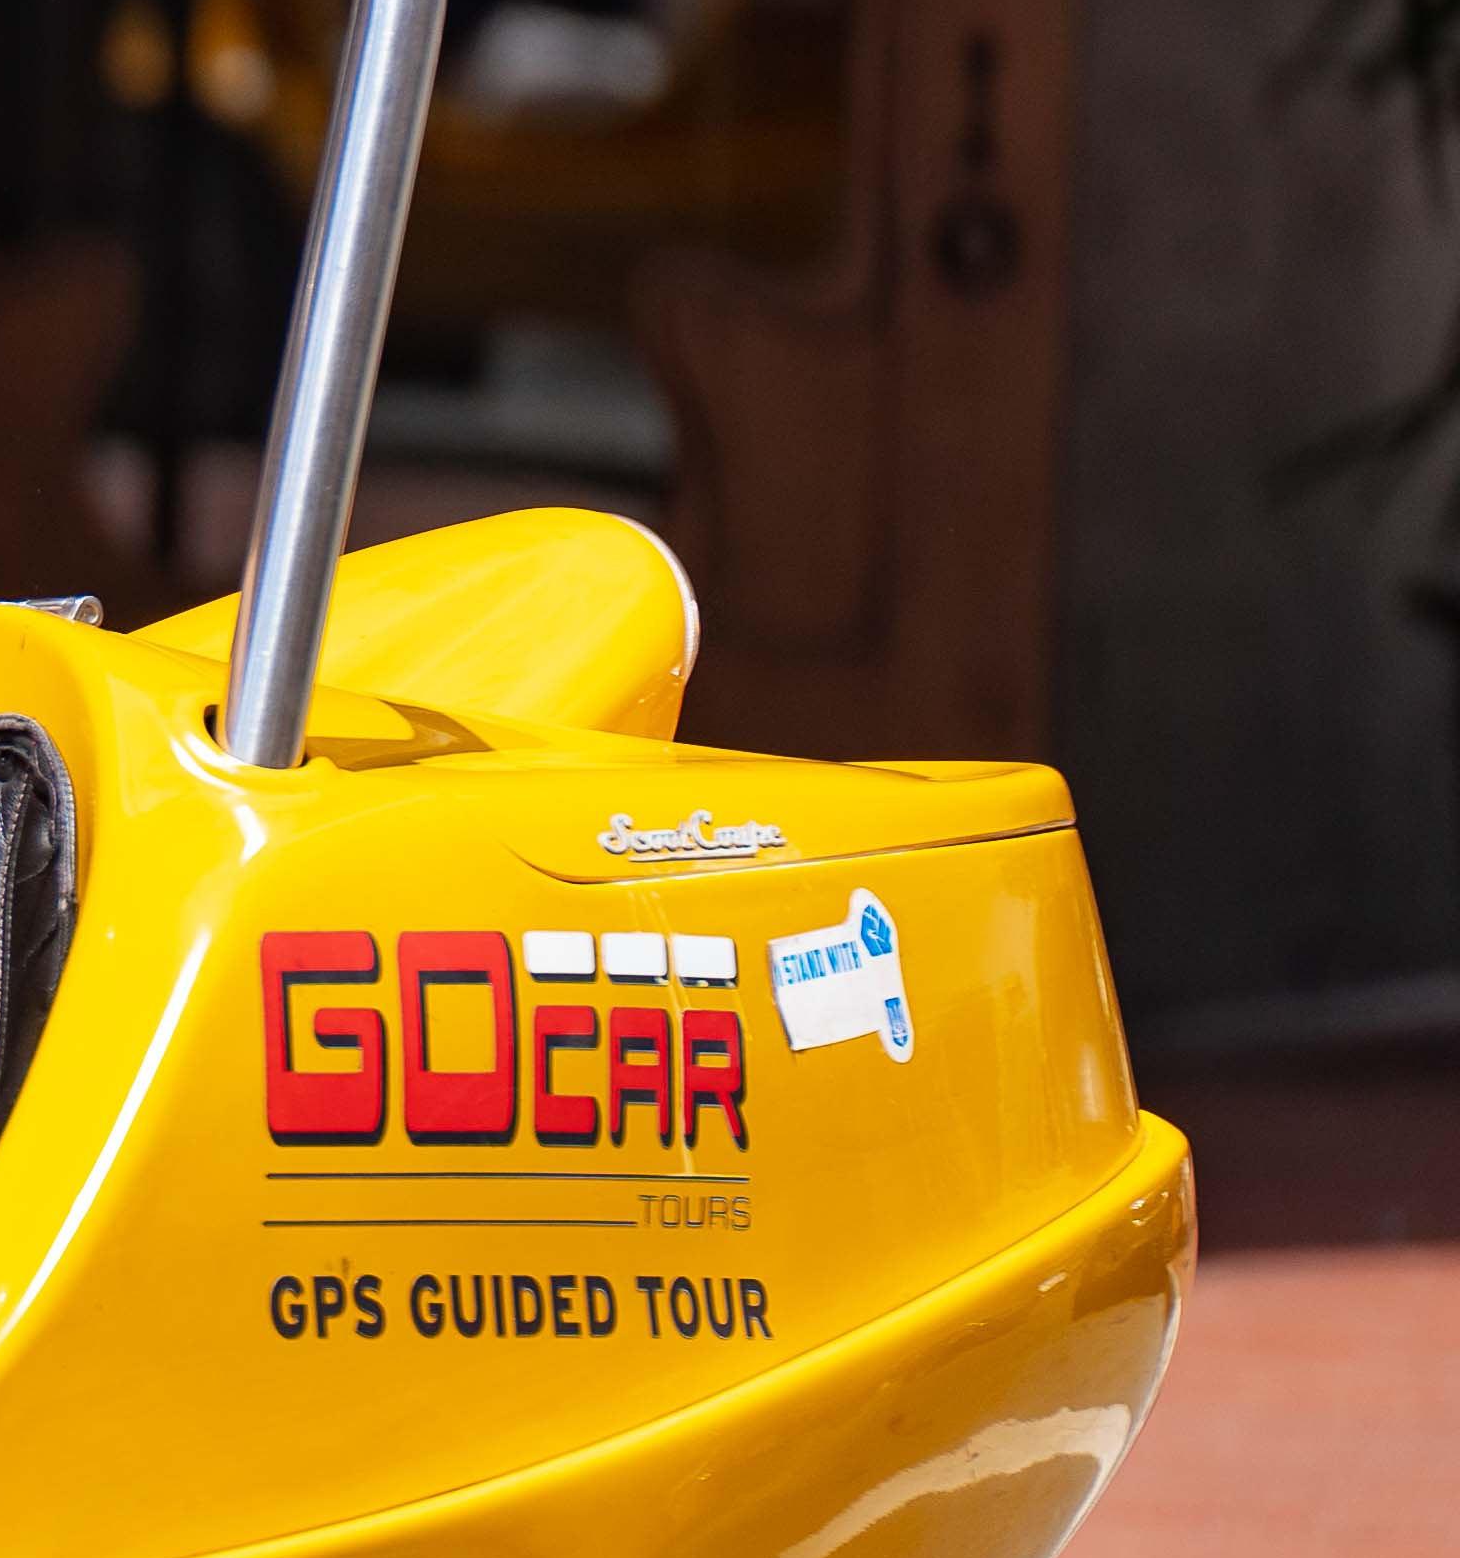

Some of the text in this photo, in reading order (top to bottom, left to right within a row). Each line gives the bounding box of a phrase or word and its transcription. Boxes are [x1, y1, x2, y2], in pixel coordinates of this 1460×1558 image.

[782, 948, 827, 985] STAND
[825, 940, 863, 975] WITH
[637, 1194, 753, 1231] TOURS
[270, 1273, 775, 1341] GPS GUIDED TOUR
